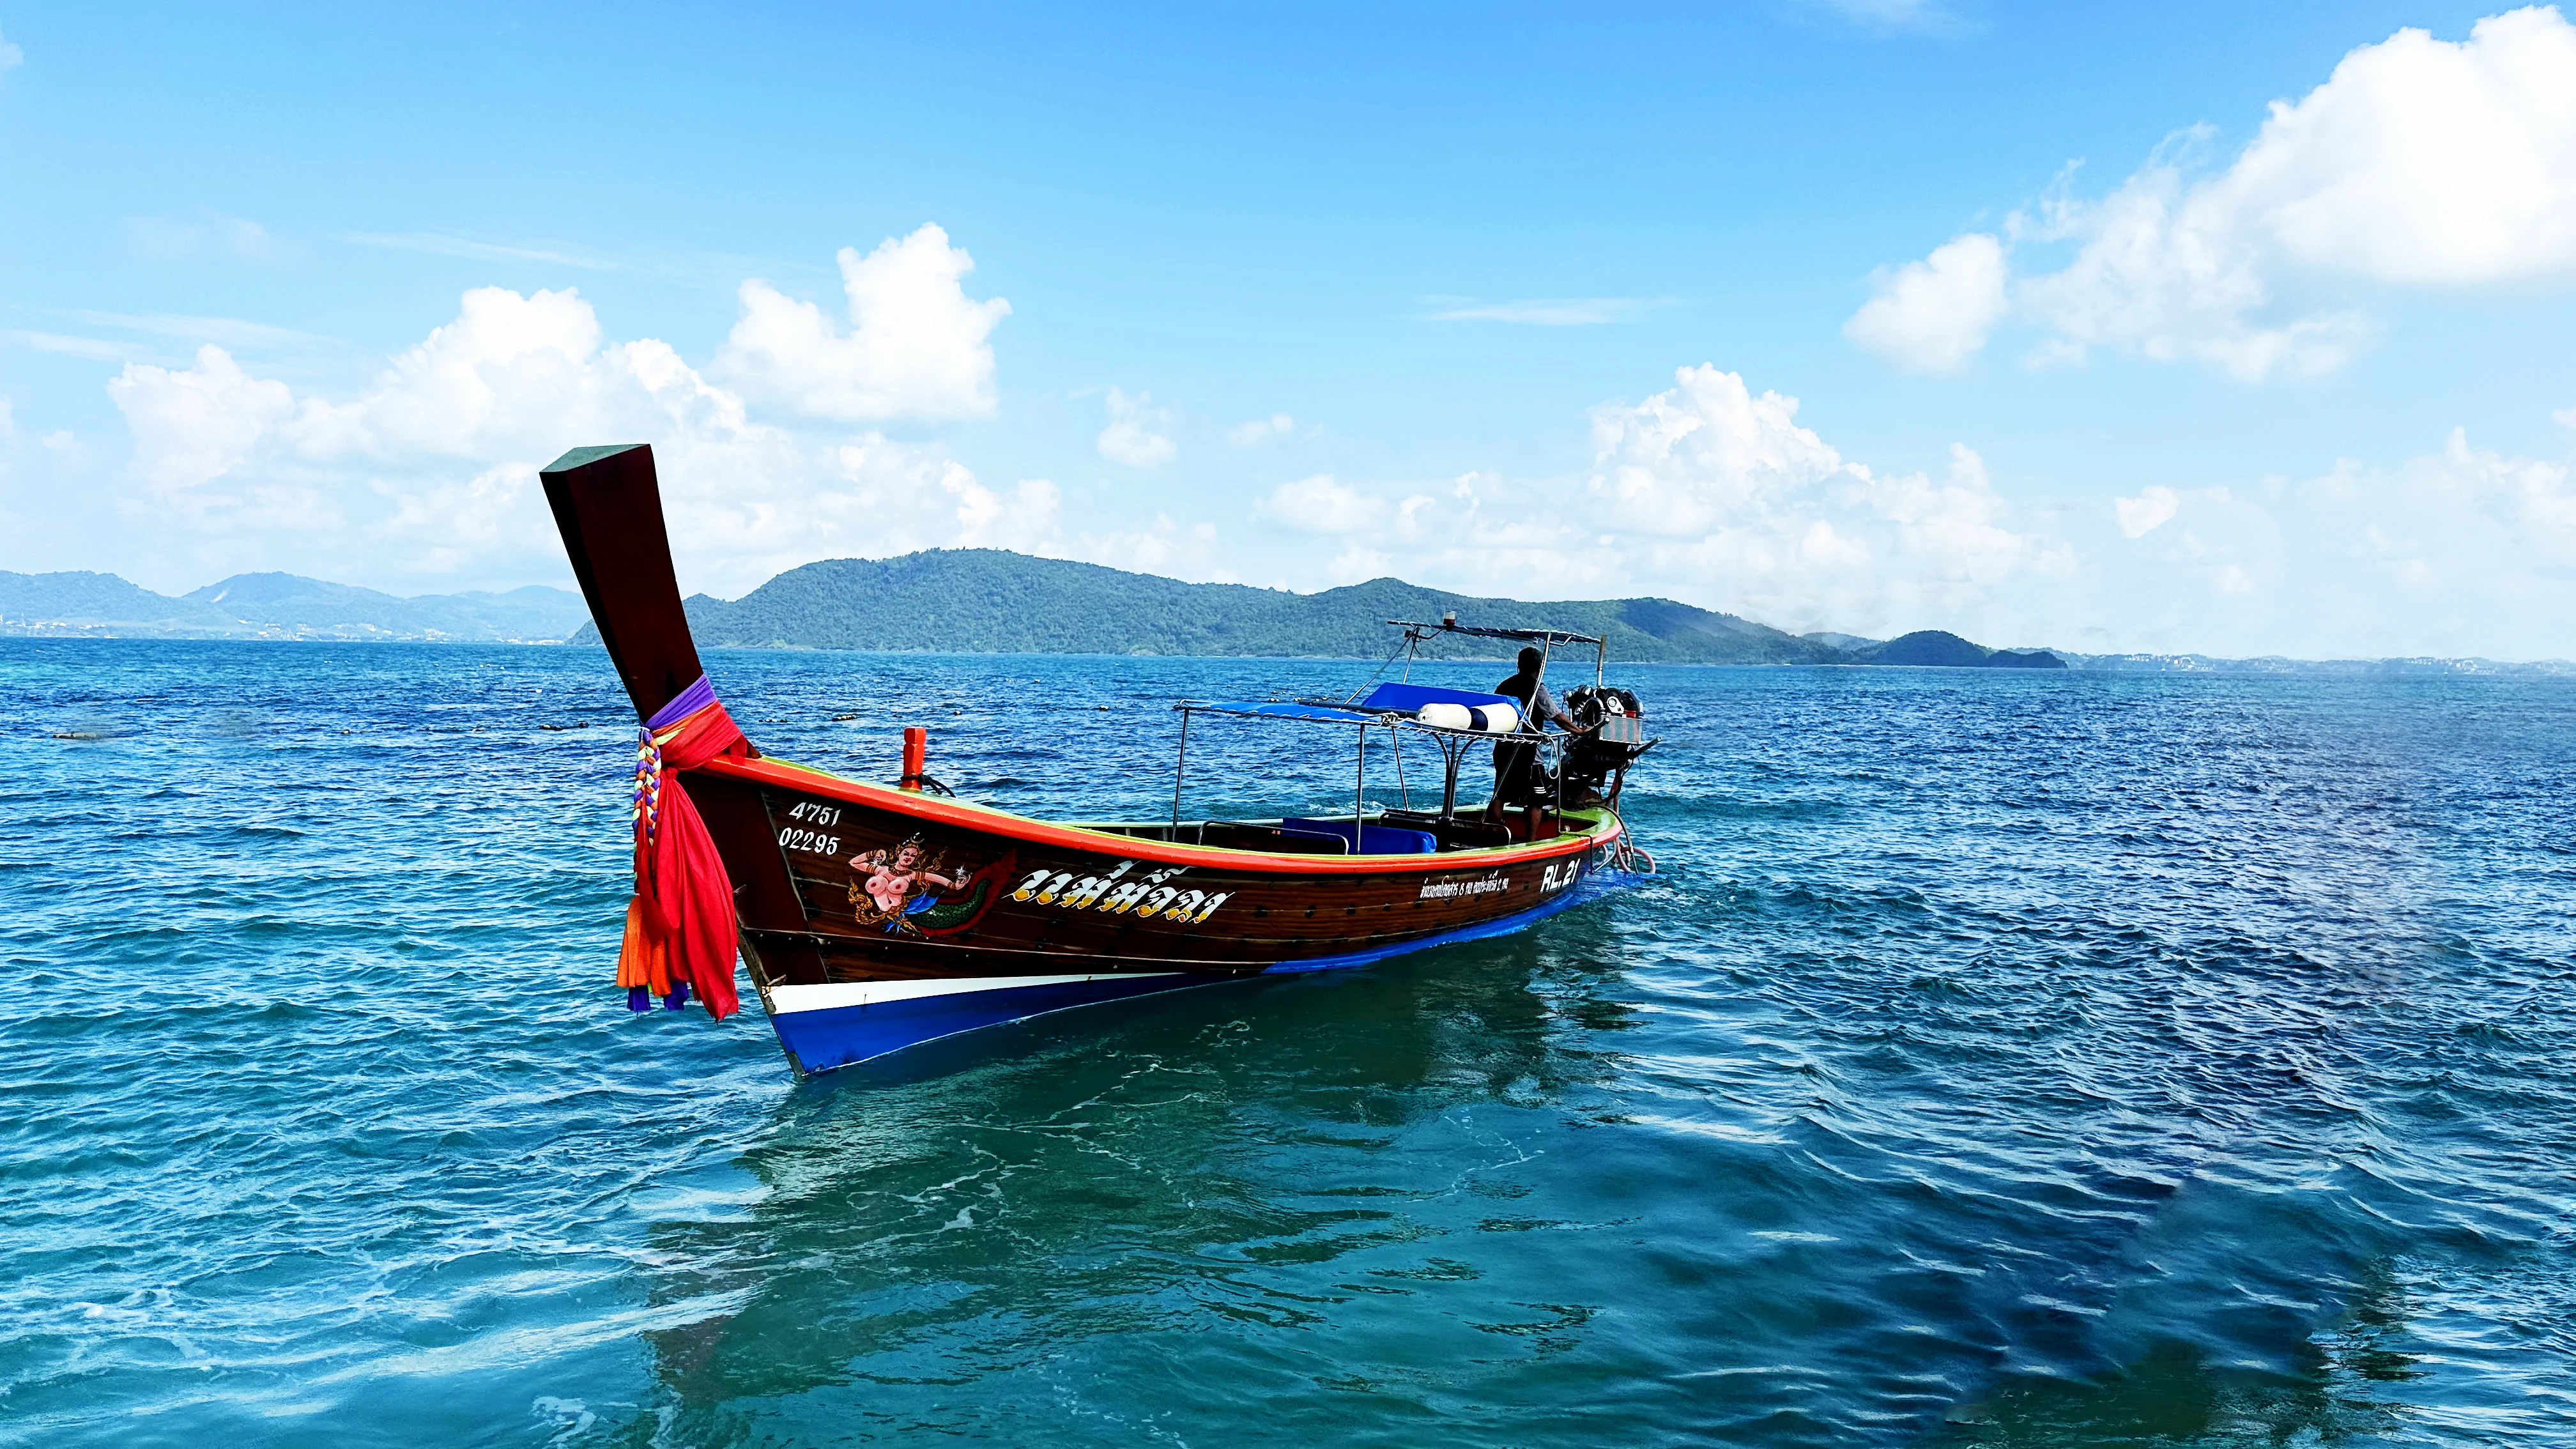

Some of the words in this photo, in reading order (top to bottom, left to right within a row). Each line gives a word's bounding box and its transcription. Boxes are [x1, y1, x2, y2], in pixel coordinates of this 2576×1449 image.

[789, 802, 841, 827] 4751
[779, 827, 841, 855] 02295
[1459, 882, 1465, 896] 8
[1540, 858, 1581, 893] RL.21
[1000, 860, 1236, 924] แม่มัจฉา
